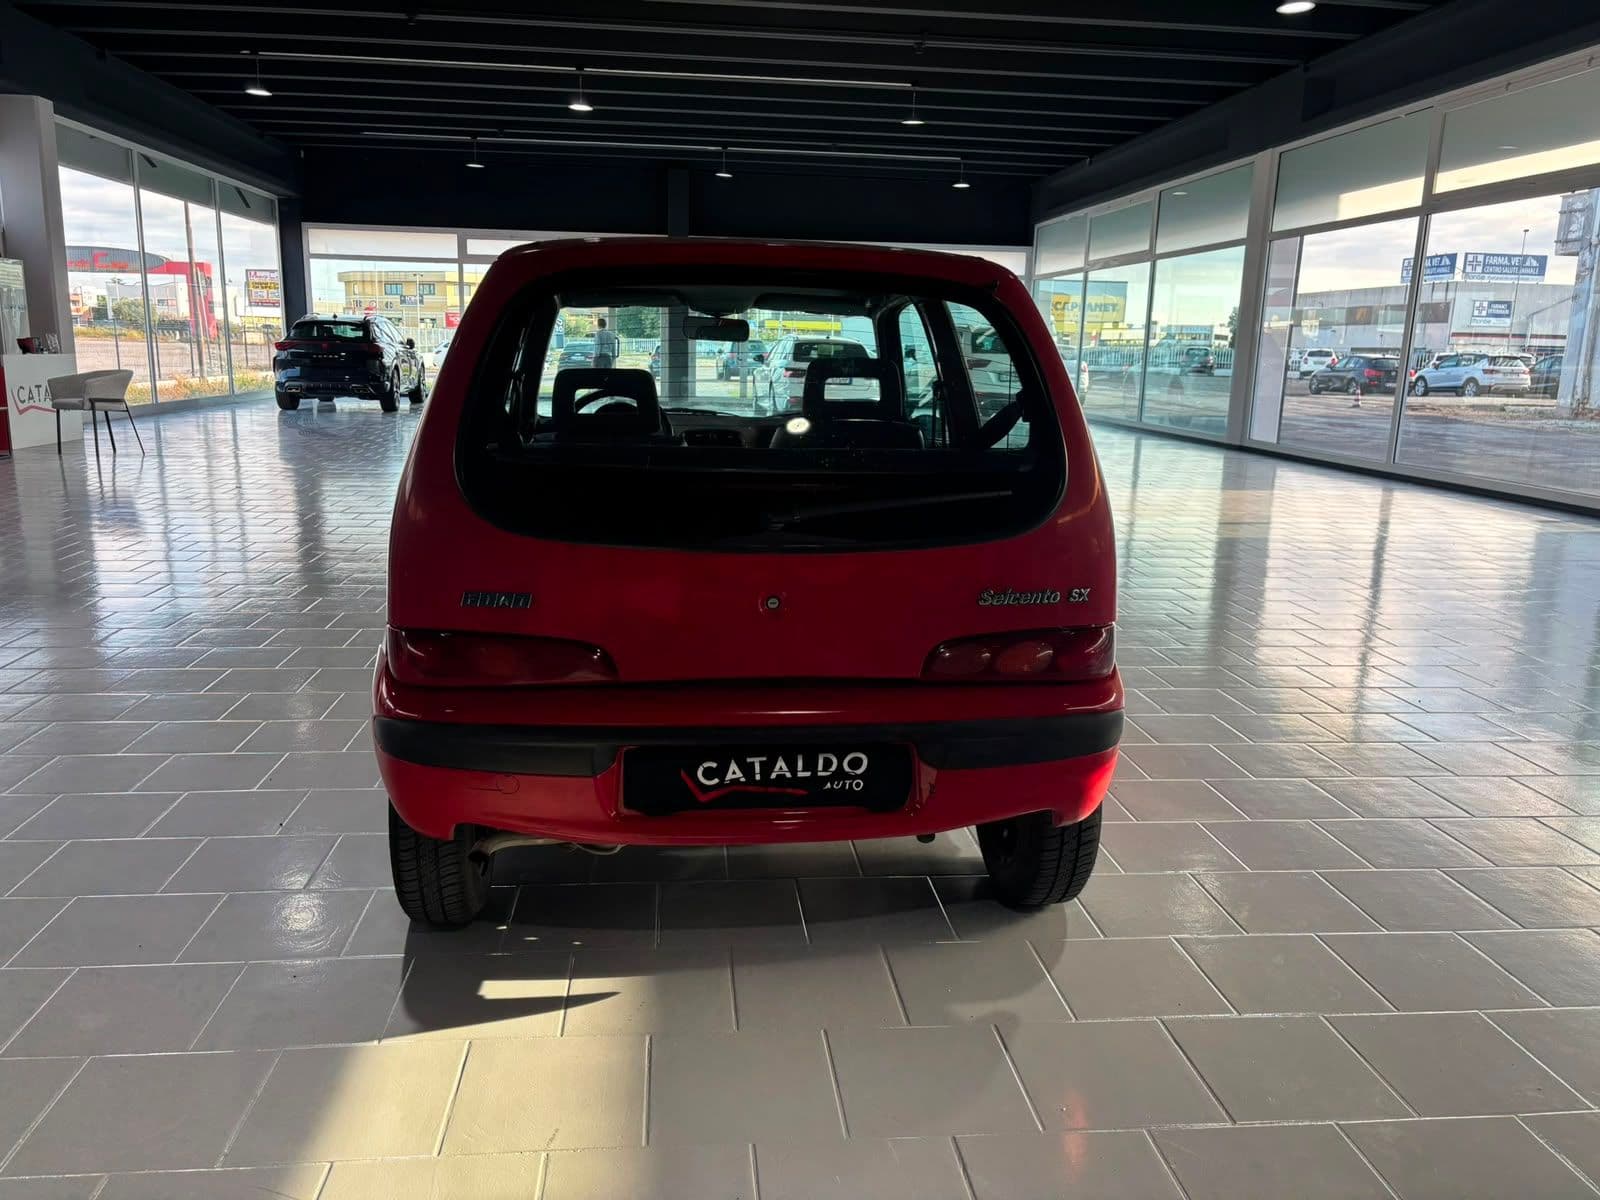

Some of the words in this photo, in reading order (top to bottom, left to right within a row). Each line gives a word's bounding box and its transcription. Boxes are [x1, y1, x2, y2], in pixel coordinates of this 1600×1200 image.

[17, 384, 51, 404] CATA
[979, 588, 1061, 605] Seicento
[1070, 588, 1091, 602] SX
[697, 752, 869, 786] CATALDO
[823, 779, 864, 791] AUTO
